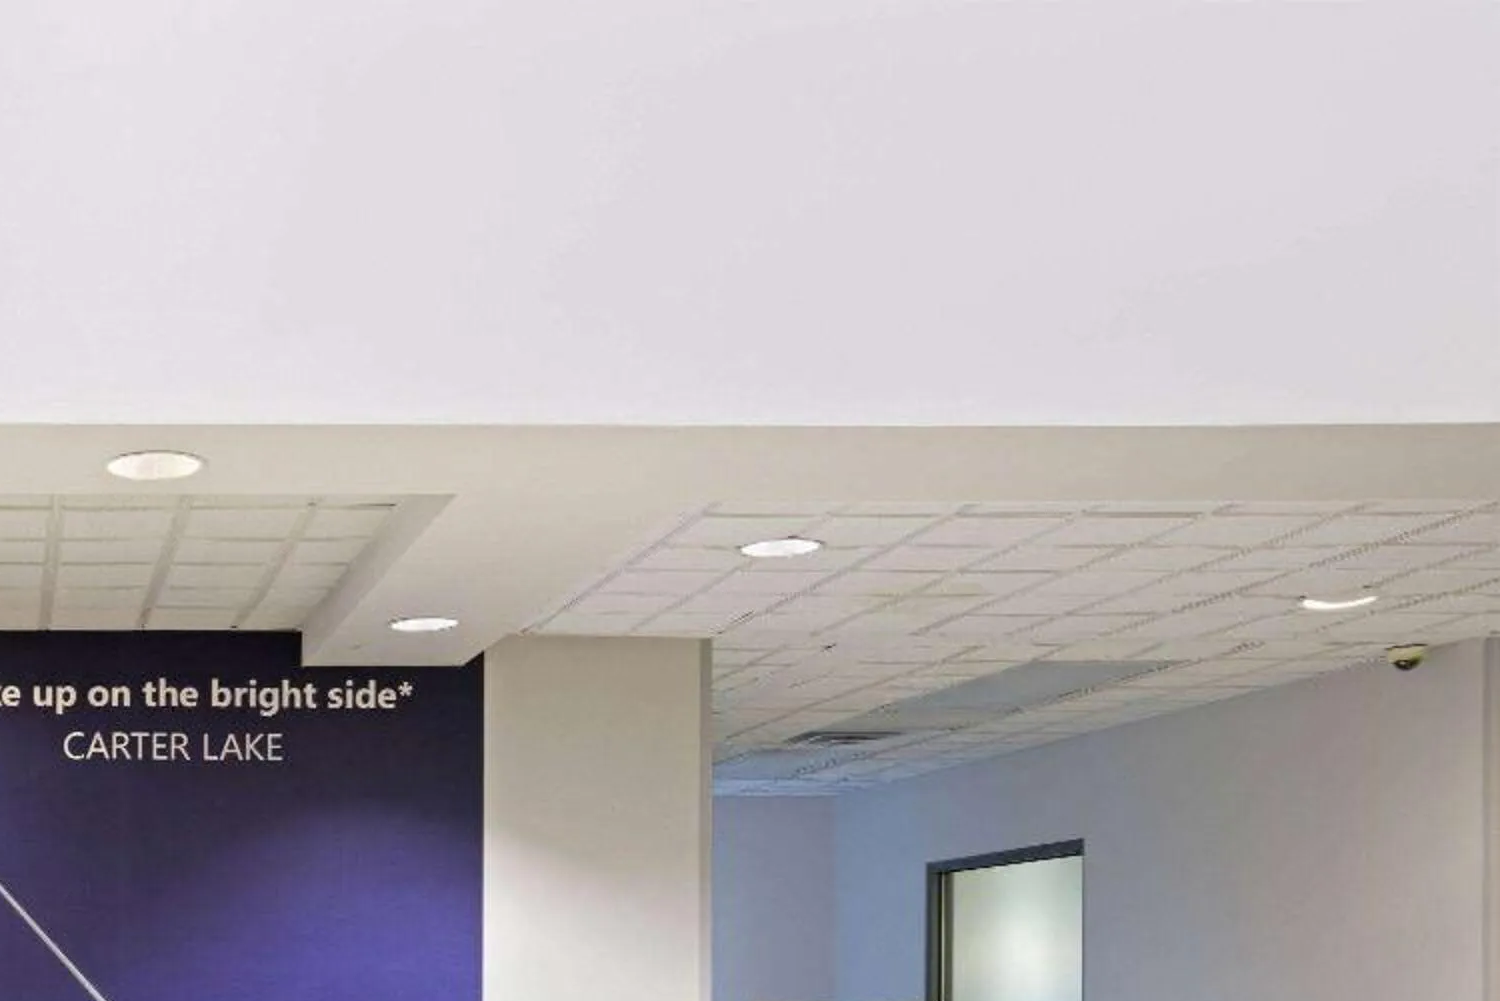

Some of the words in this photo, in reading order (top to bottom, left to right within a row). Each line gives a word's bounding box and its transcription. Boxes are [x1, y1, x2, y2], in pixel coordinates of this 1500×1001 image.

[33, 685, 77, 716] up
[87, 684, 131, 708] on
[142, 677, 199, 708] the
[211, 678, 317, 717] bright
[62, 731, 190, 762] CARTER
[202, 732, 284, 762] LAKE
